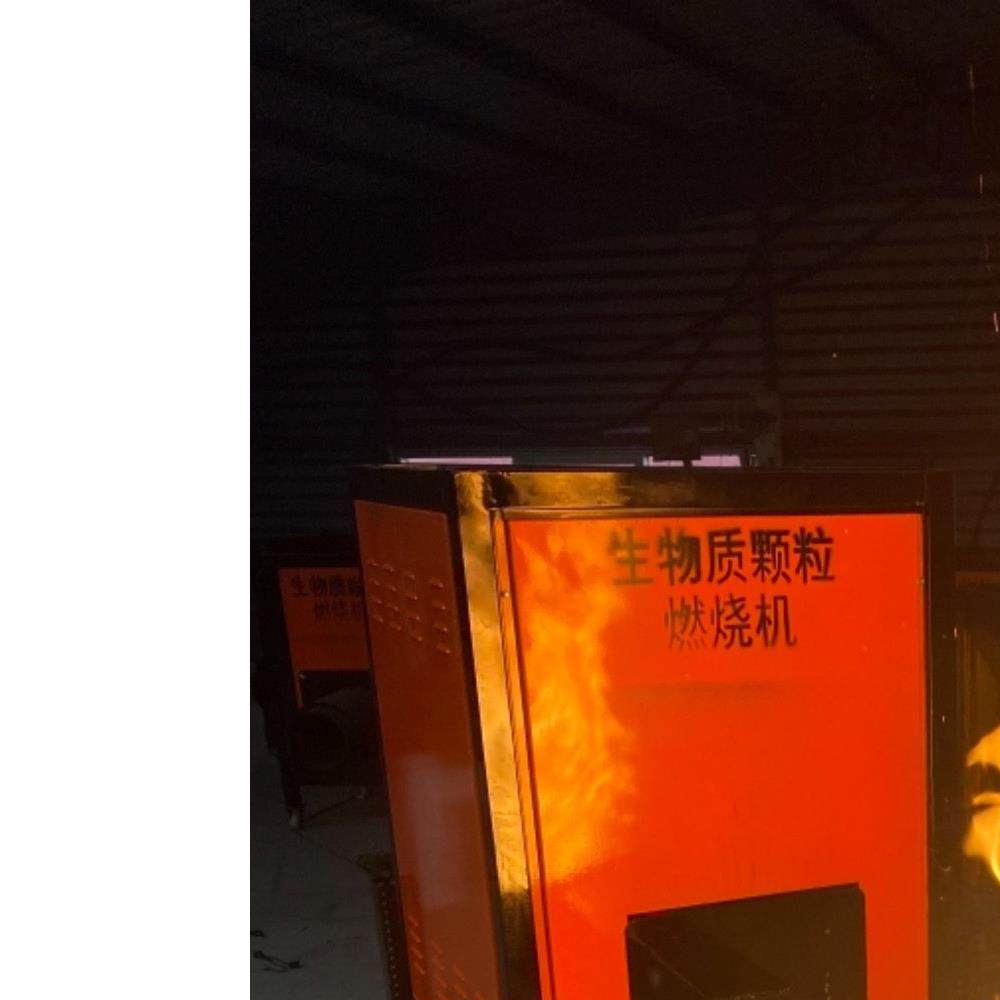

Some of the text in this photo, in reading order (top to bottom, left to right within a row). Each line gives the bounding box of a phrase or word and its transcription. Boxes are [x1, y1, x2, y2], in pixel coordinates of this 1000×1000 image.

[608, 526, 835, 586] 生物质颗粒
[664, 593, 797, 650] 燃烧机
